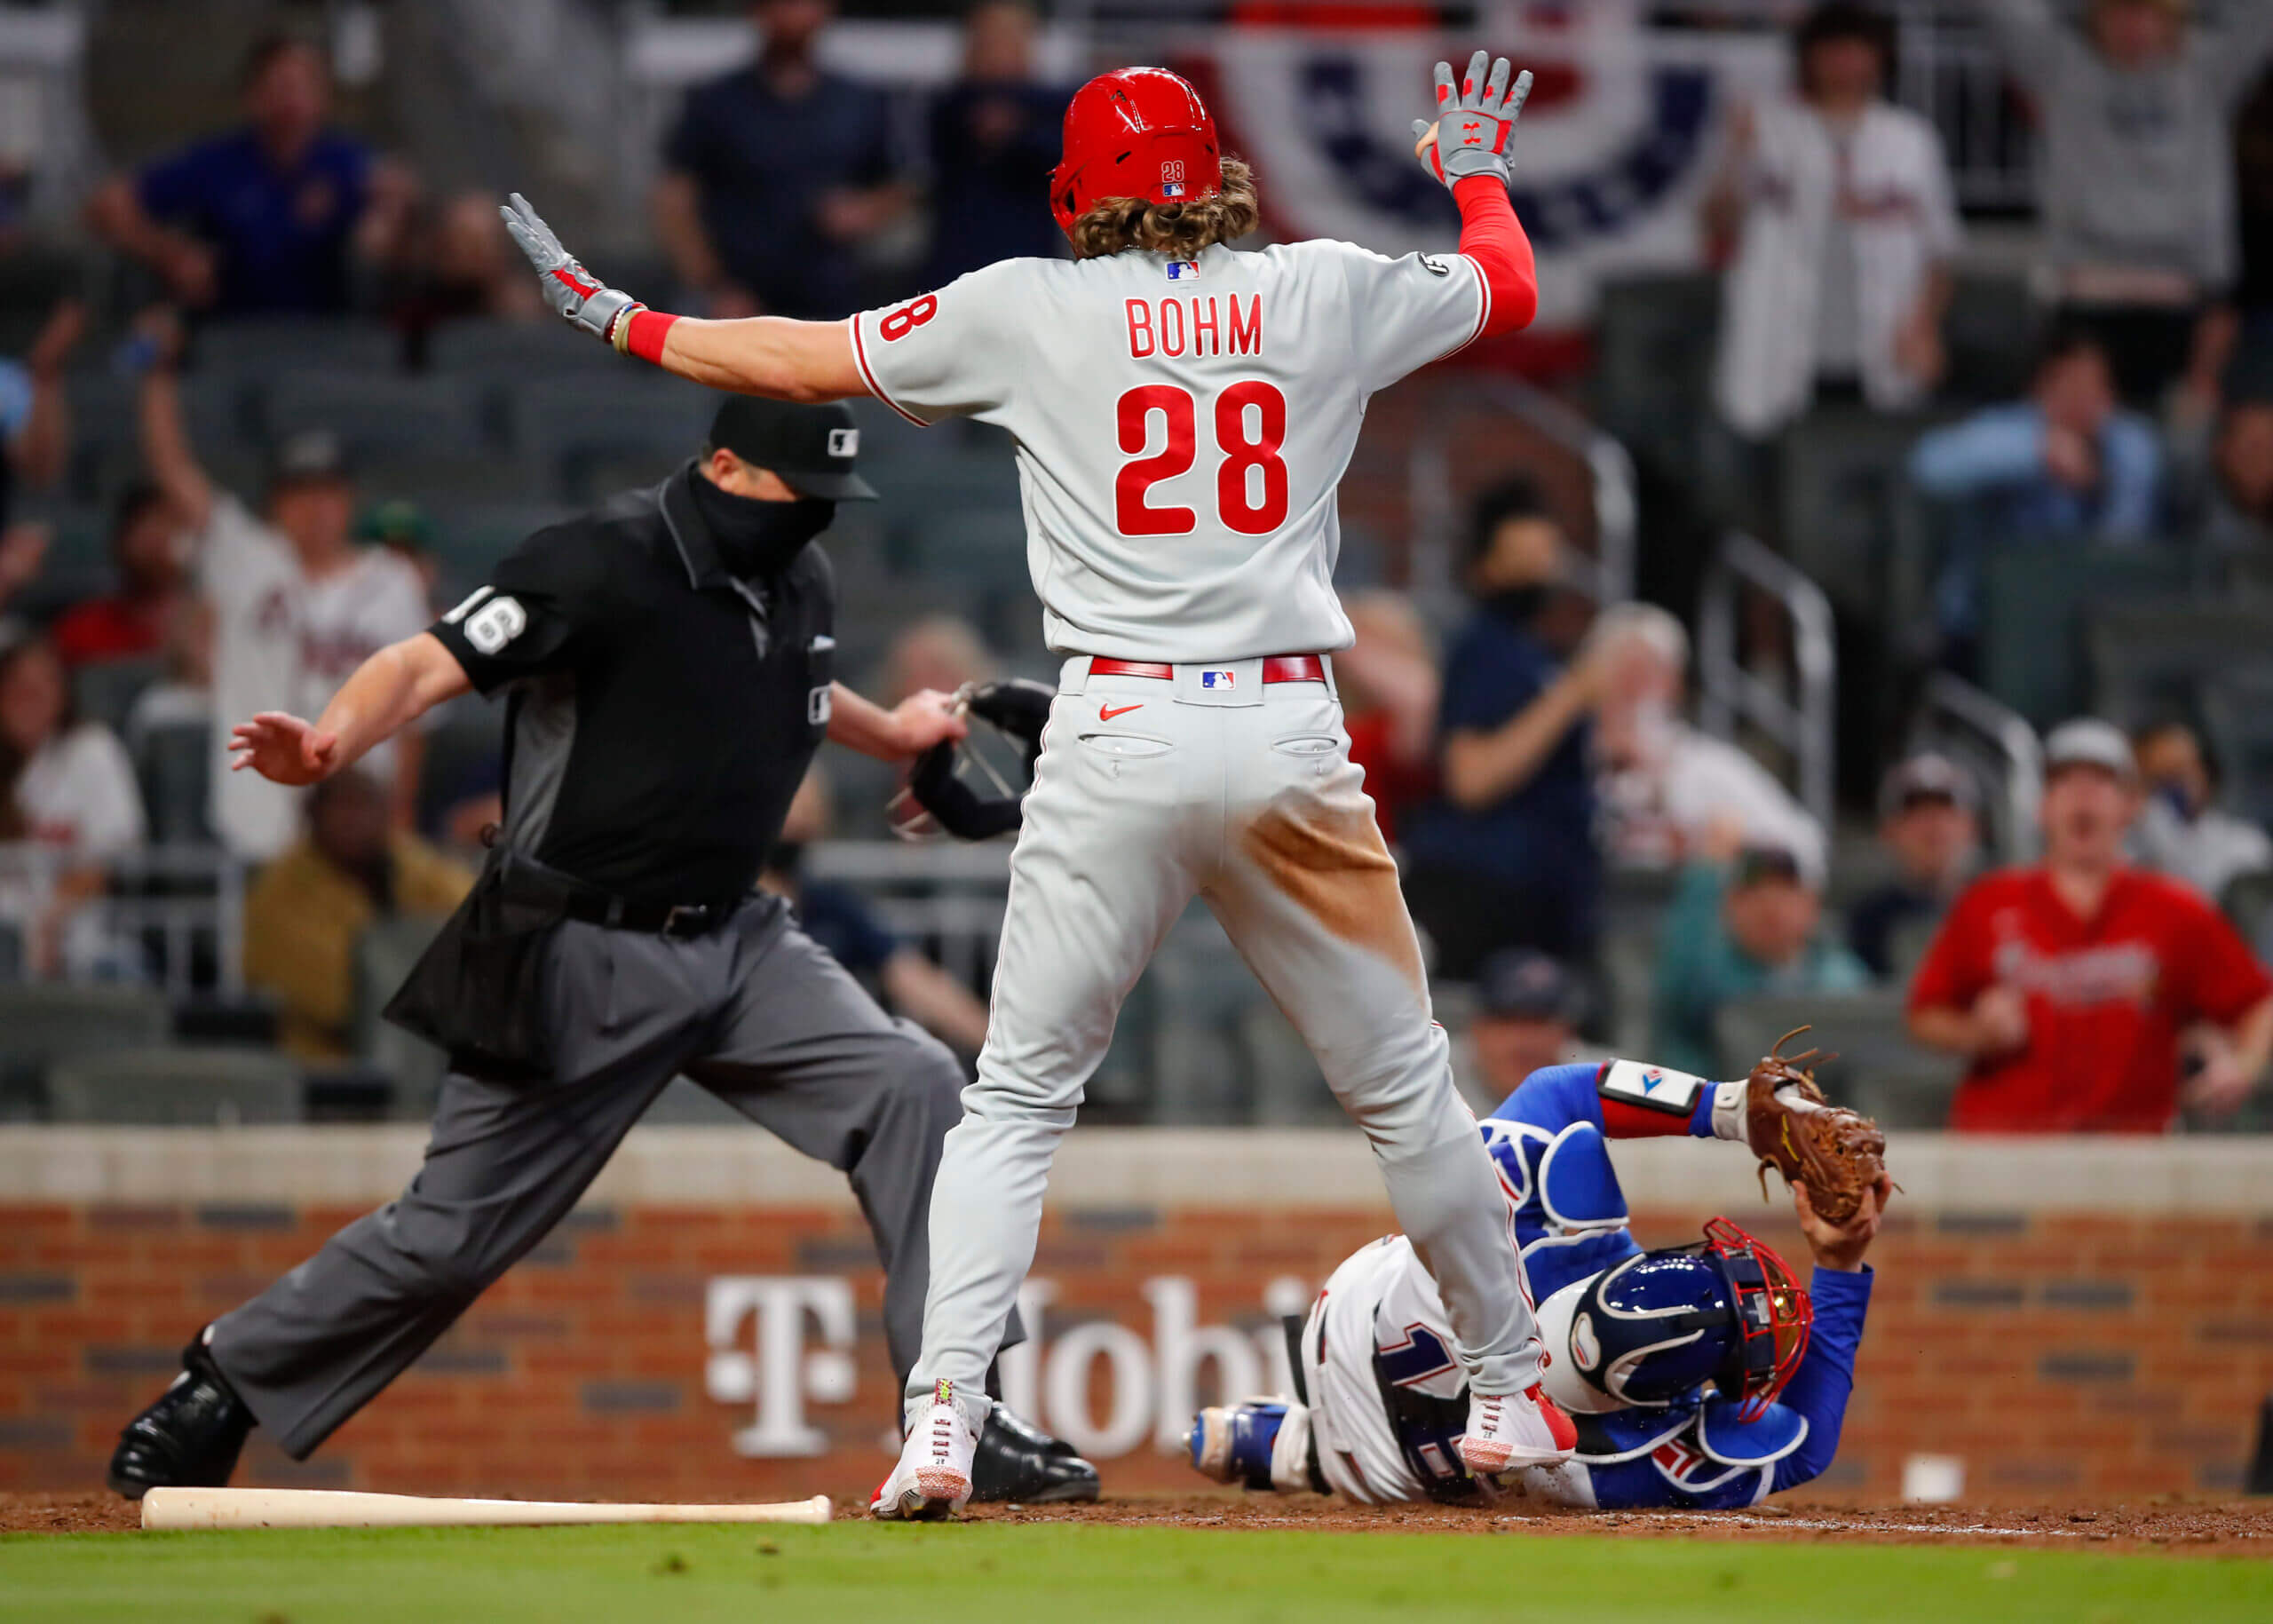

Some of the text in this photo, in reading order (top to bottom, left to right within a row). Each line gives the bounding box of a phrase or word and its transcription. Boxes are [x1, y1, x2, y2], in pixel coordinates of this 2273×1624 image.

[1160, 160, 1184, 183] 28
[1124, 291, 1263, 360] BOHM
[1115, 378, 1289, 537] 28
[441, 585, 527, 654] 16
